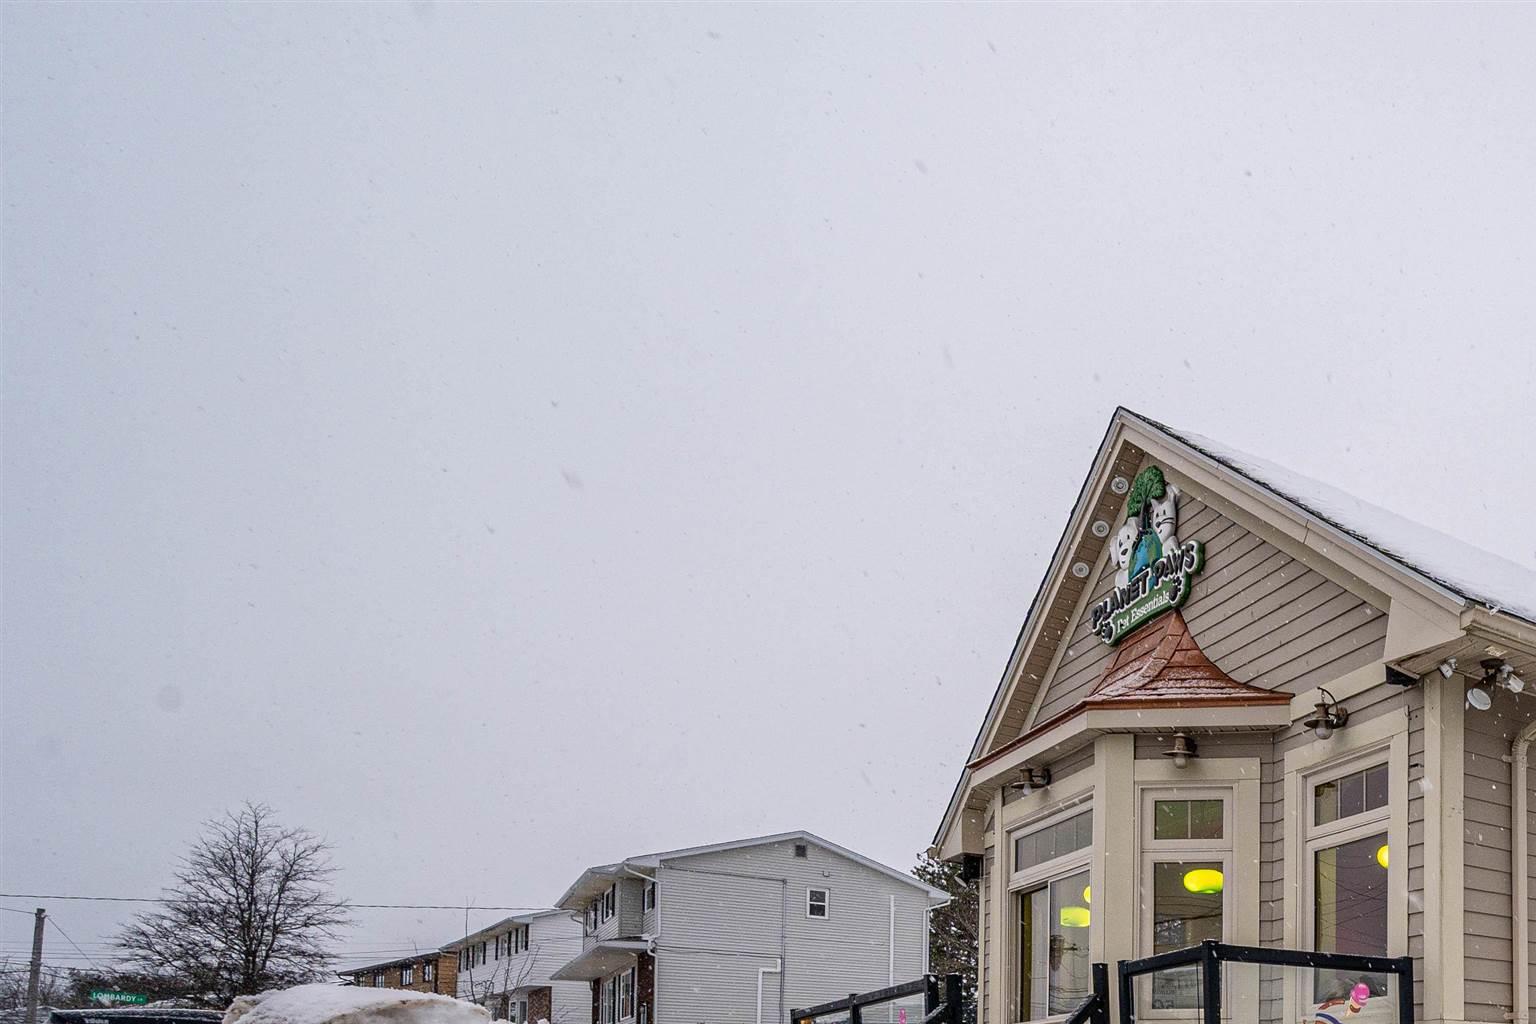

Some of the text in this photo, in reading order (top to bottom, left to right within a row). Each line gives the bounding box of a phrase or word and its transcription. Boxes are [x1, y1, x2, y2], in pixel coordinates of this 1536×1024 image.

[1091, 541, 1197, 632] PLANET PAWS
[1117, 590, 1170, 634] Pet Essentials
[92, 991, 137, 1002] LOMBARDY
